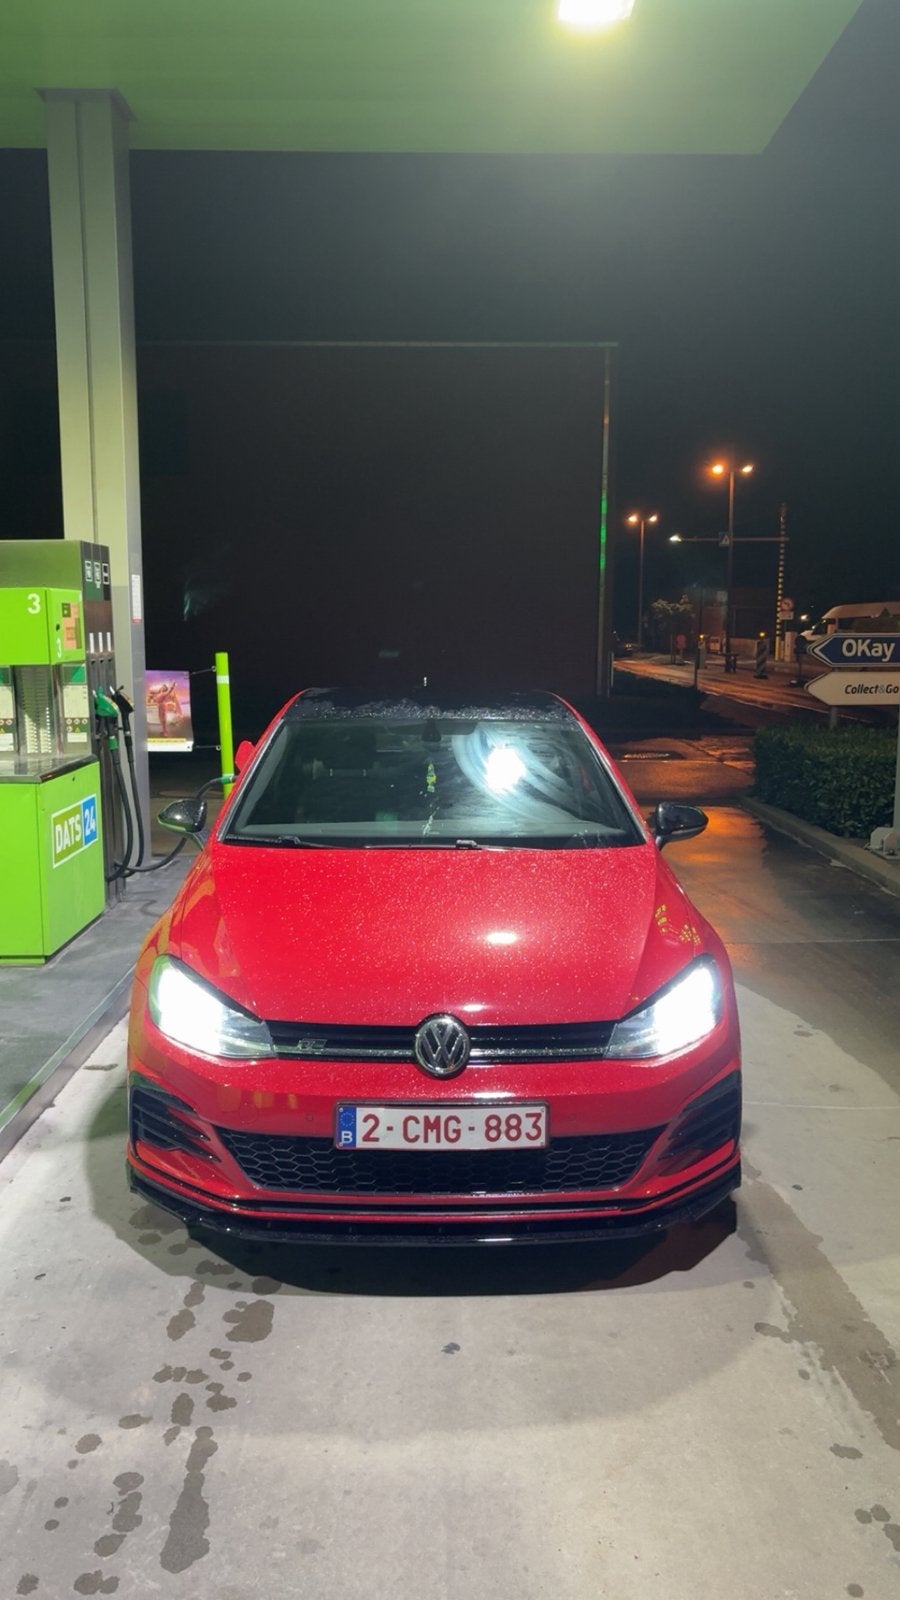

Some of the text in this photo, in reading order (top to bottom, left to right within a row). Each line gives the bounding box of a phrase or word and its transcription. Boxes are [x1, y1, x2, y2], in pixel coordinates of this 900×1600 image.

[27, 593, 41, 614] 3
[842, 639, 896, 662] OKay
[55, 806, 96, 854] DATS 24
[341, 1131, 353, 1144] B
